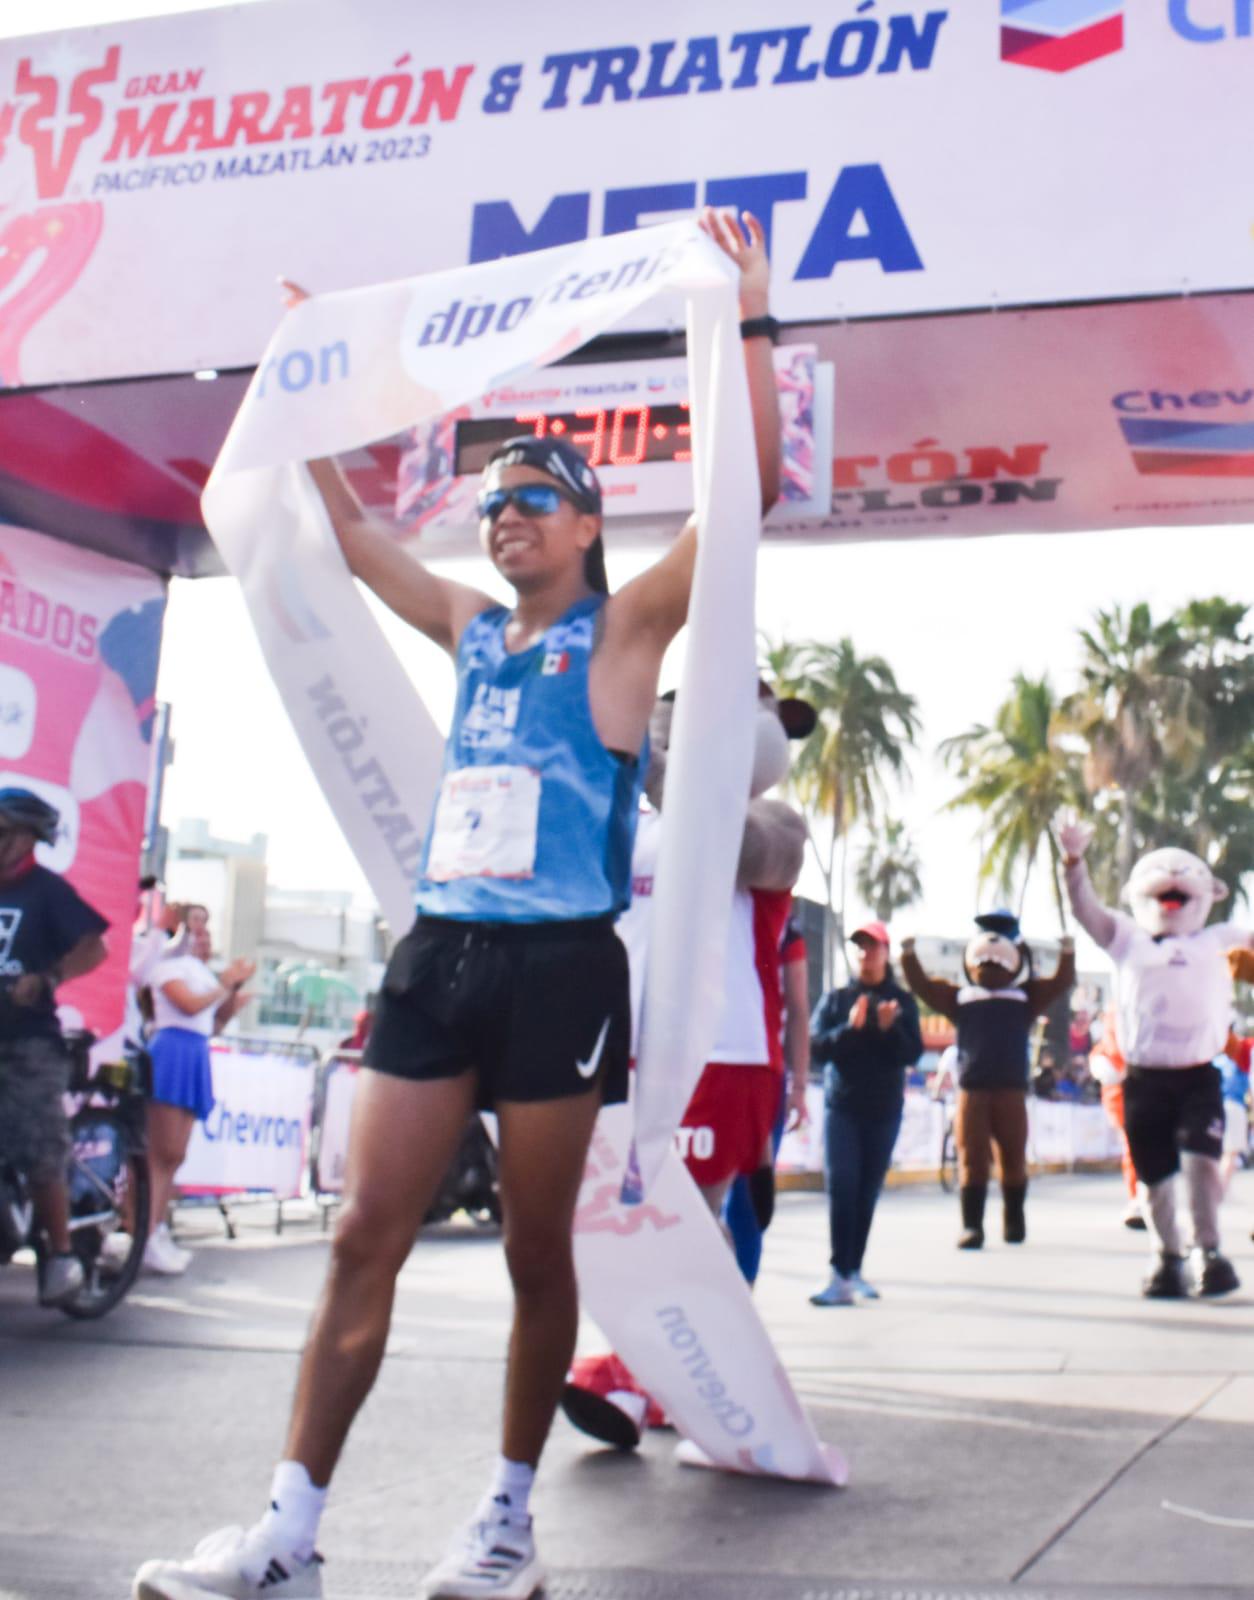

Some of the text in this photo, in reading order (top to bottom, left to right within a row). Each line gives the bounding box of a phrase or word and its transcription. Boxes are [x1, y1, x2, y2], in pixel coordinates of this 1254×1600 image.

[102, 0, 949, 163] MARATÓN & TRIATLÓN
[125, 68, 204, 99] GRAN
[91, 134, 433, 195] PACÍFICO MAZATLÁN 2023
[1111, 388, 1254, 413] Chev
[0, 580, 98, 658] ADOS
[203, 1100, 302, 1147] Chevron
